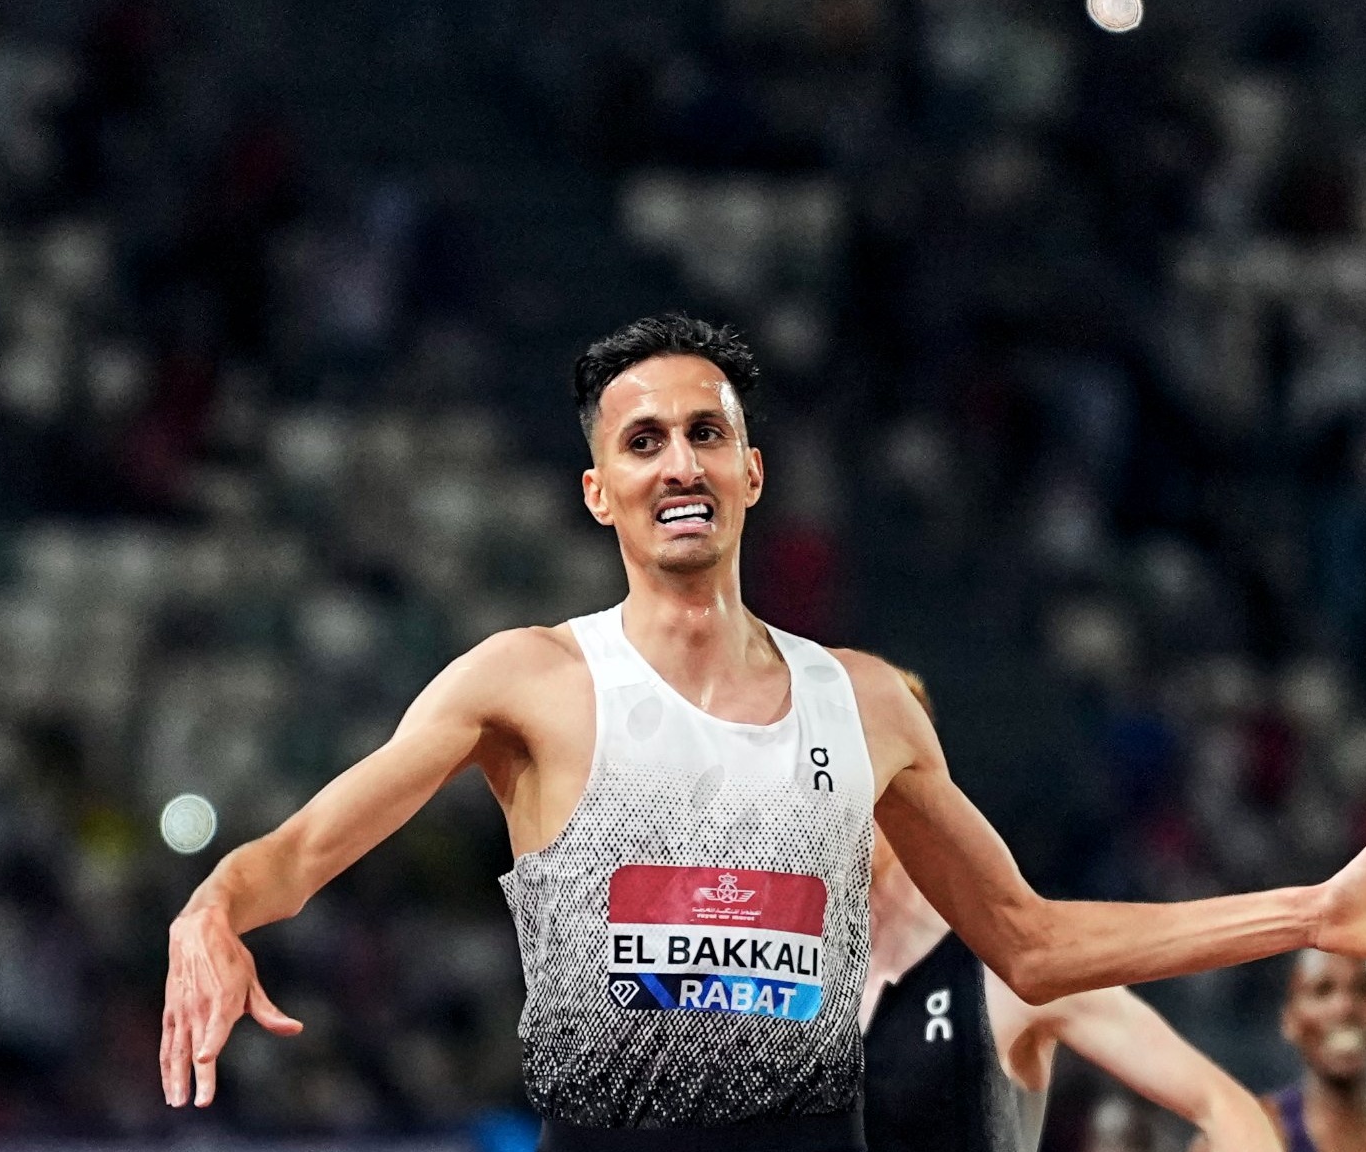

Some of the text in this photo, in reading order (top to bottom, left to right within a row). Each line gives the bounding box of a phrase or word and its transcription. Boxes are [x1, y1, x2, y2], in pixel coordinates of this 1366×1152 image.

[613, 935, 818, 977] EL BAKKALI
[678, 979, 797, 1016] RABAT
